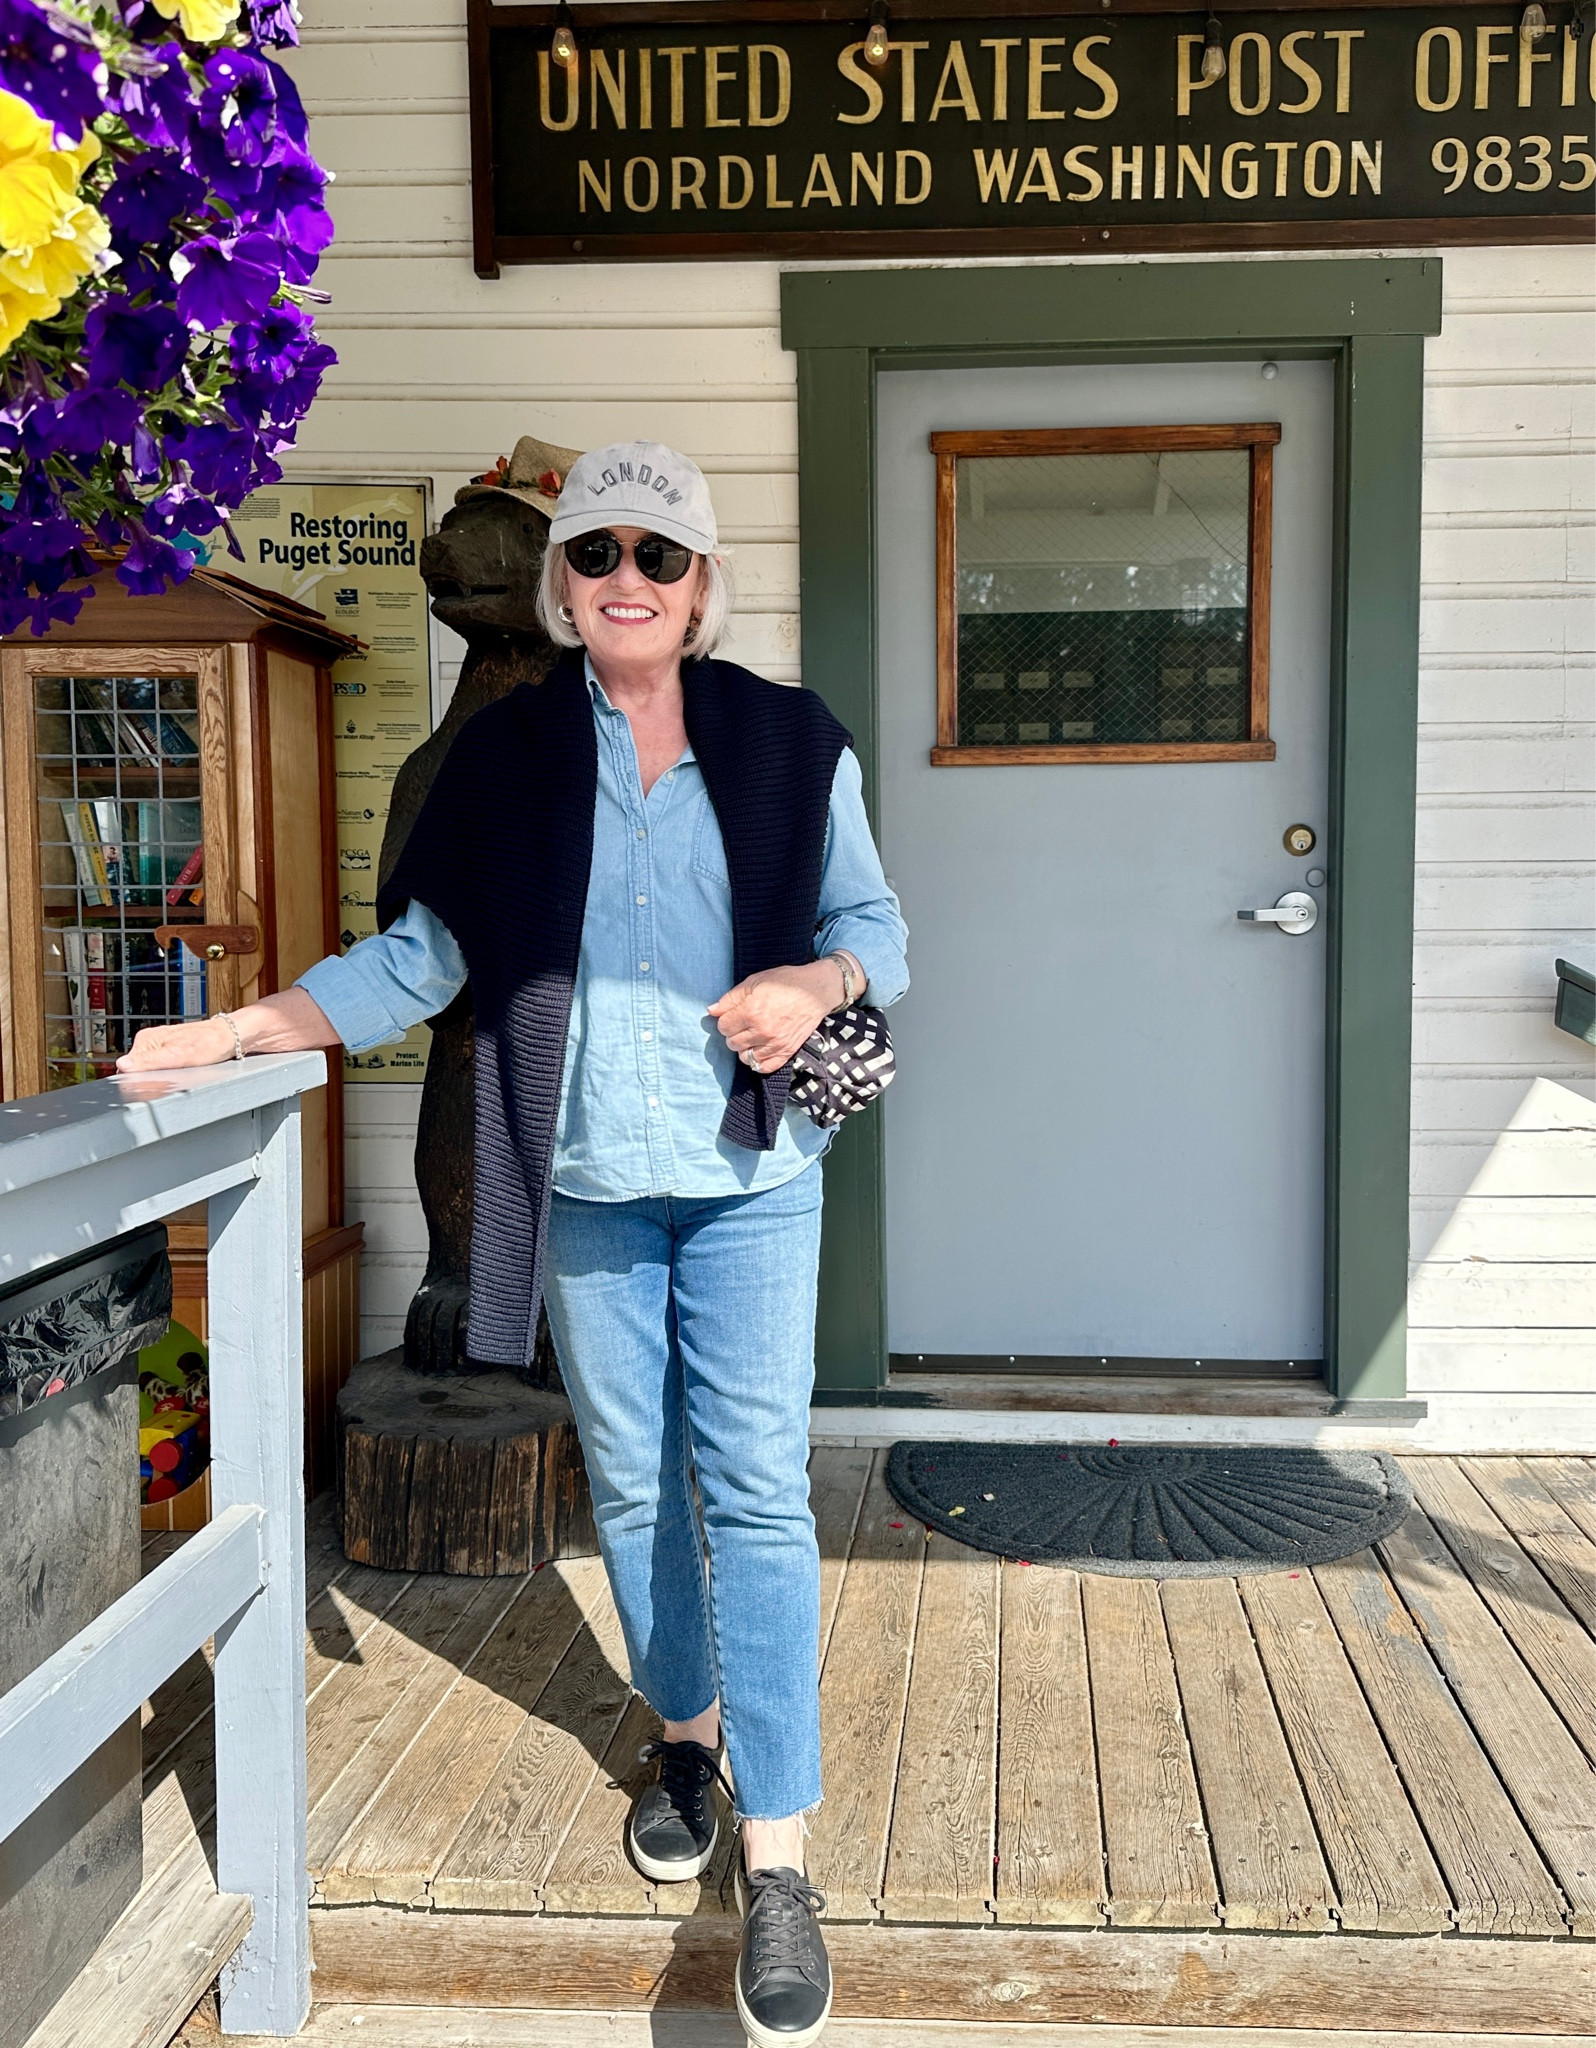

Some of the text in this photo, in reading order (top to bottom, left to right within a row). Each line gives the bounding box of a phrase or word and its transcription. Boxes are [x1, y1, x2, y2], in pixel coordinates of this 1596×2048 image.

[536, 26, 1595, 132] UNITED STATES POST OFFI
[578, 149, 933, 213] NORDLAND
[972, 139, 1383, 203] WASHINGTON
[587, 461, 683, 506] LONDON
[290, 512, 408, 547] Restoring
[259, 538, 416, 572] Puget Sound
[340, 848, 371, 857] PCSGA
